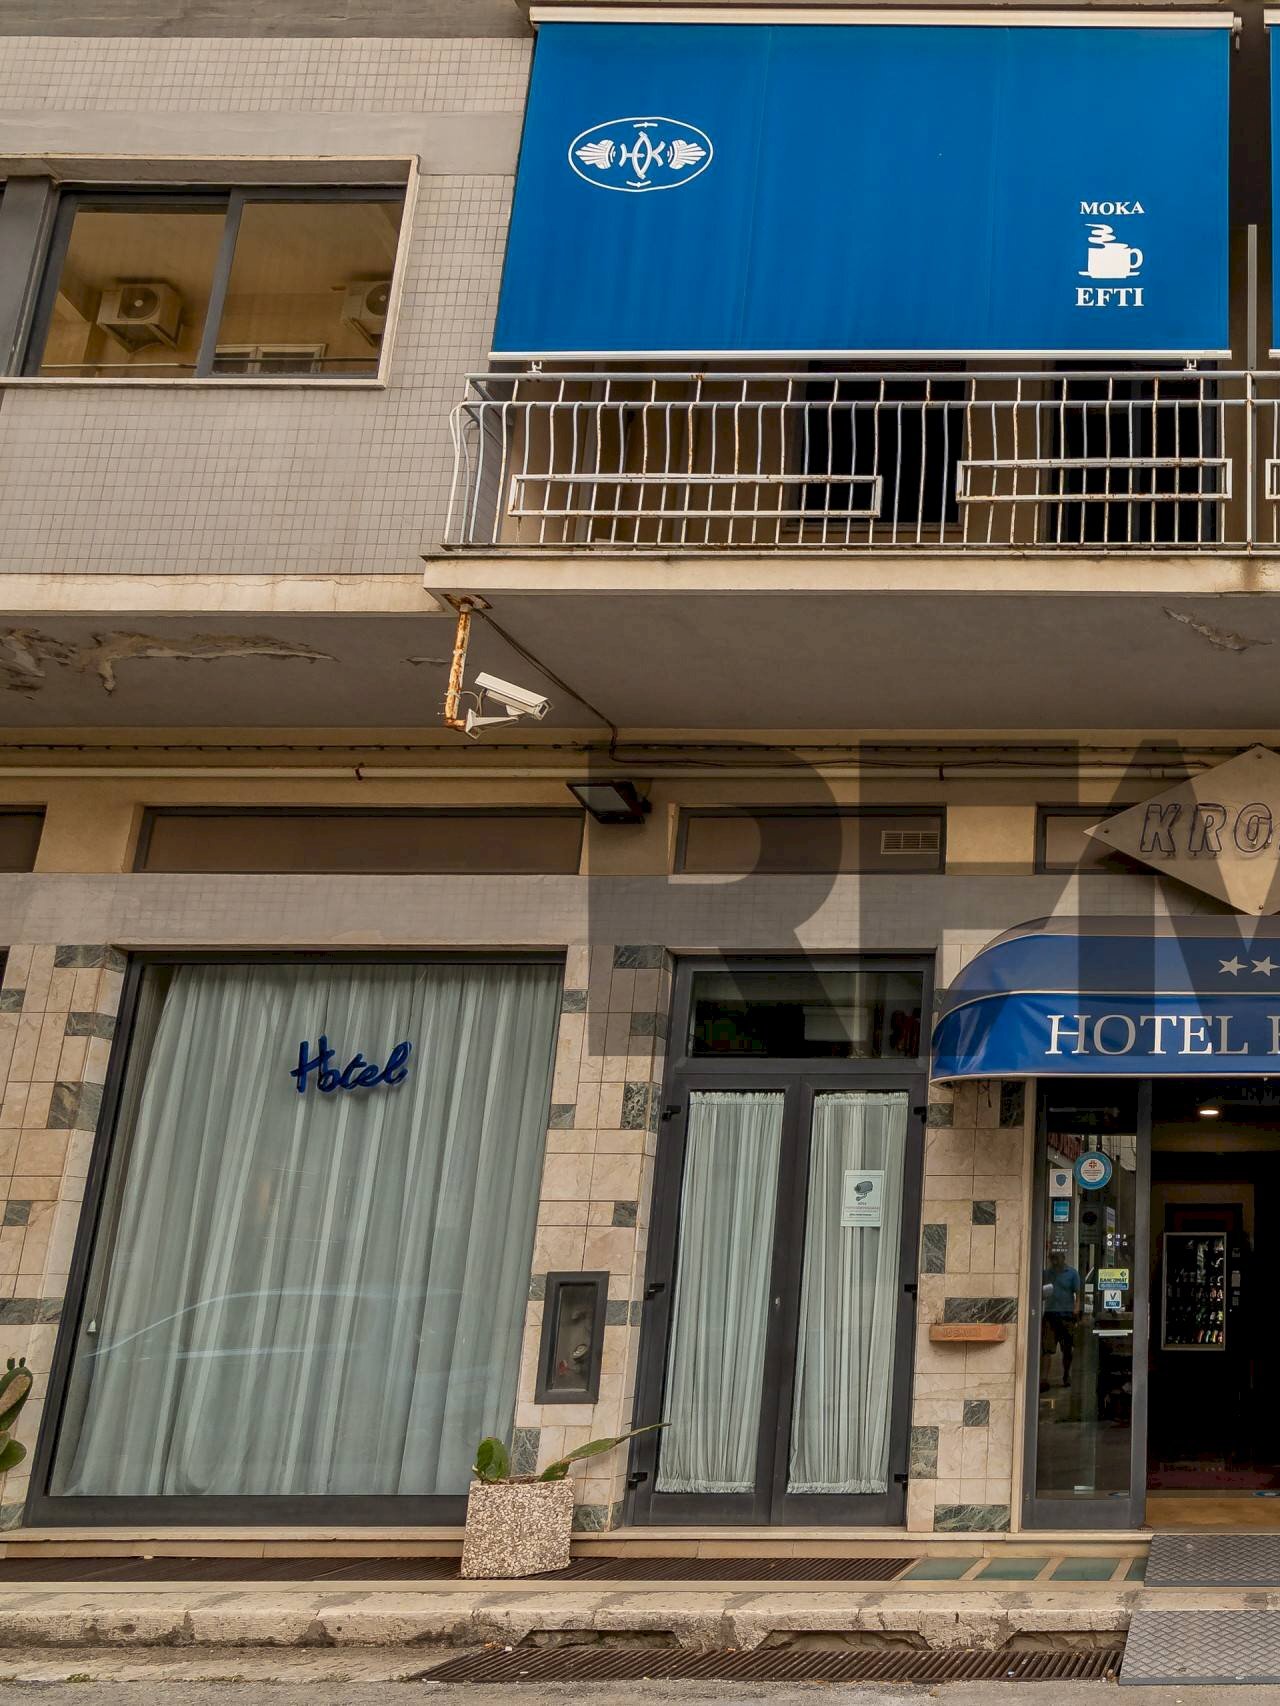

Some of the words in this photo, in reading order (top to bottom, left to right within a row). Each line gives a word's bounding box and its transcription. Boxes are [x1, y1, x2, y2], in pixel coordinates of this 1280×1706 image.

[1079, 200, 1145, 215] MOKA
[1075, 287, 1145, 307] EFTI
[1044, 1012, 1249, 1056] HOTEL
[290, 1034, 413, 1093] Hotel
